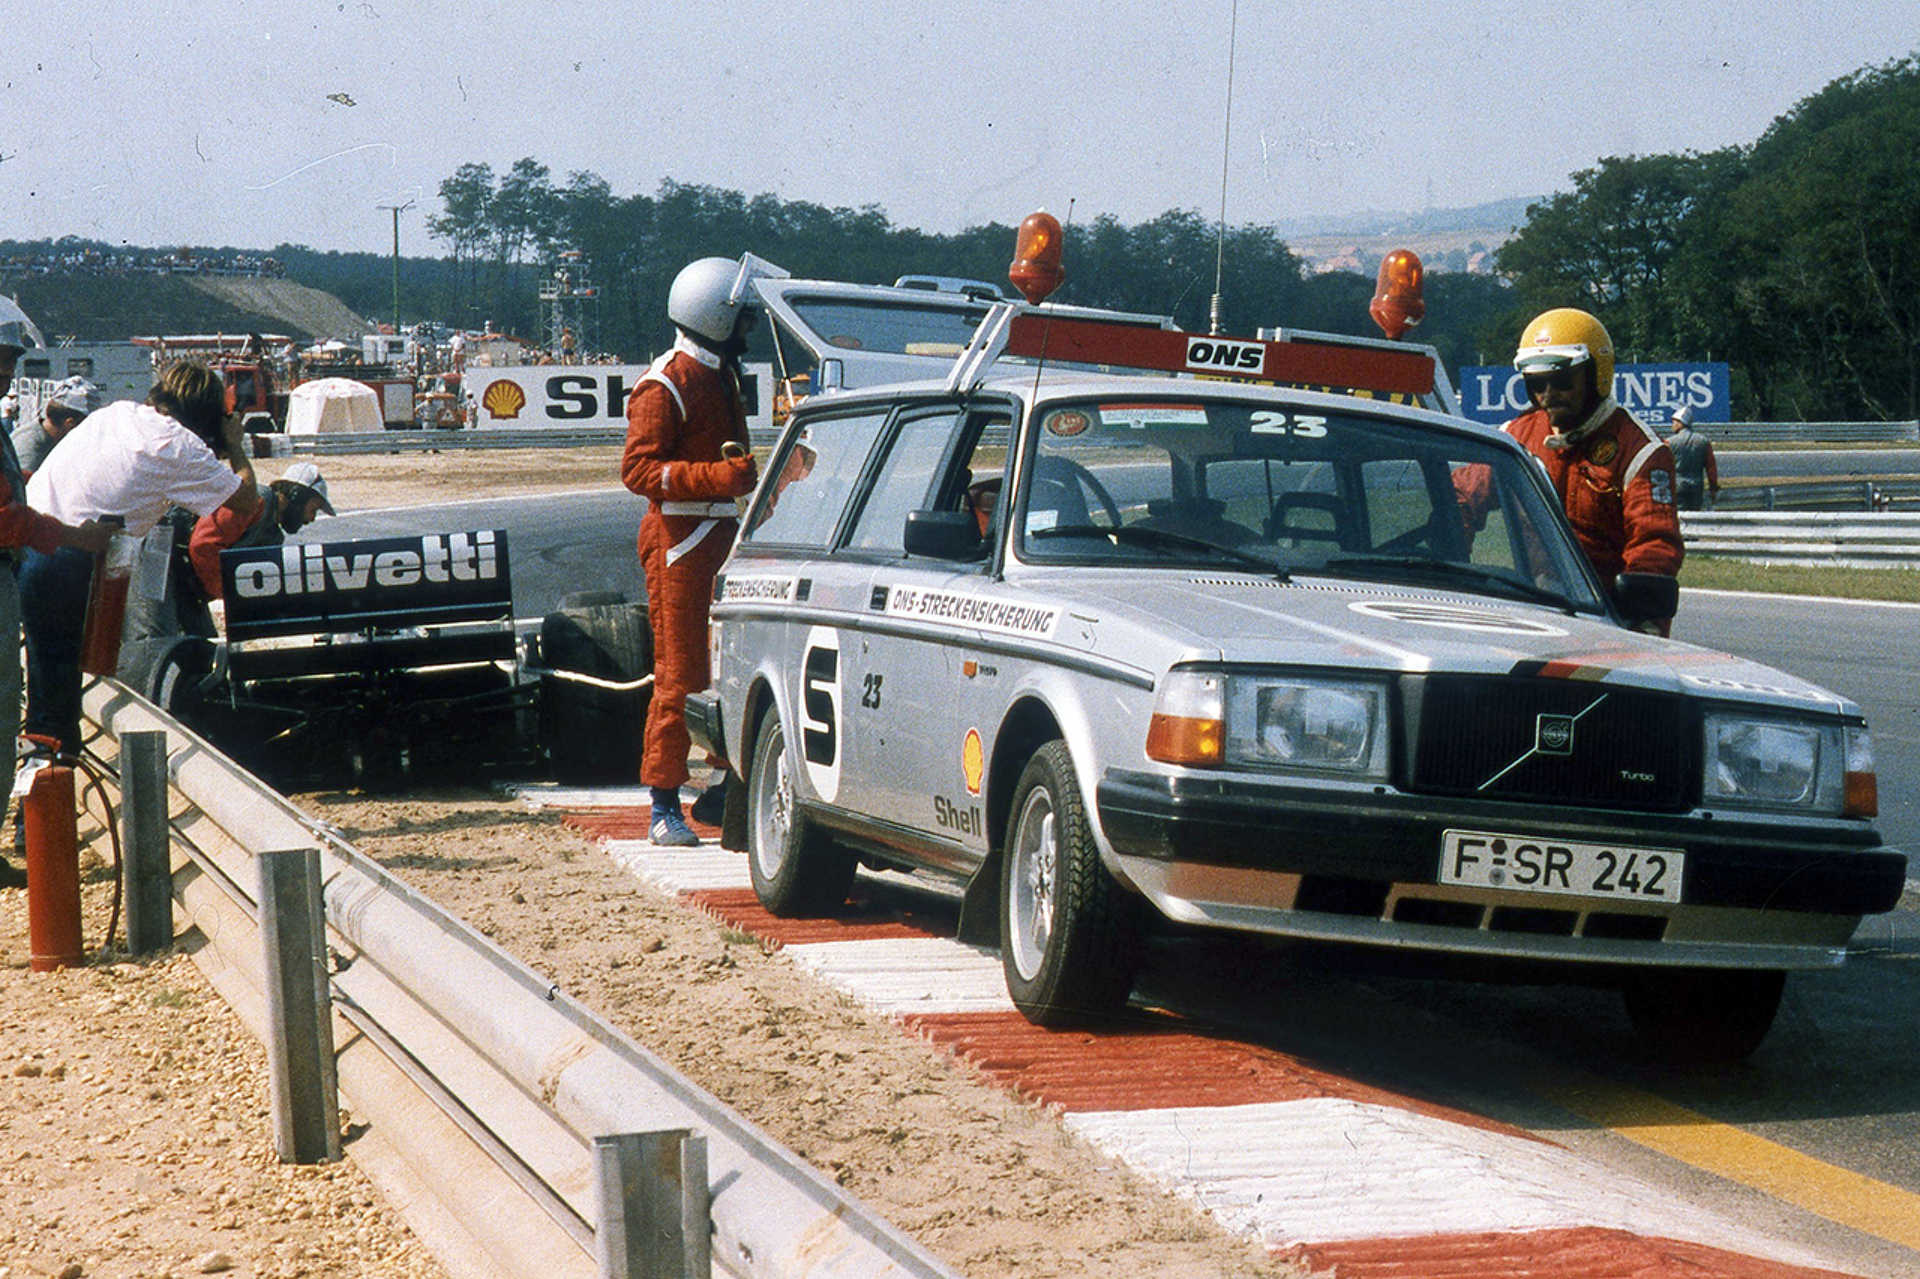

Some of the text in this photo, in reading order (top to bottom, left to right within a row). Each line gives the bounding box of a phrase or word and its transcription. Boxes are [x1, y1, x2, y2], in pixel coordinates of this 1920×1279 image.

[1189, 342, 1264, 368] ONS
[1250, 410, 1328, 438] 23
[234, 530, 498, 598] olivetti
[803, 645, 839, 767] S
[861, 672, 883, 709] 23
[1620, 769, 1655, 782] Turbo
[933, 795, 982, 838] Shell
[1592, 850, 1668, 896] 242
